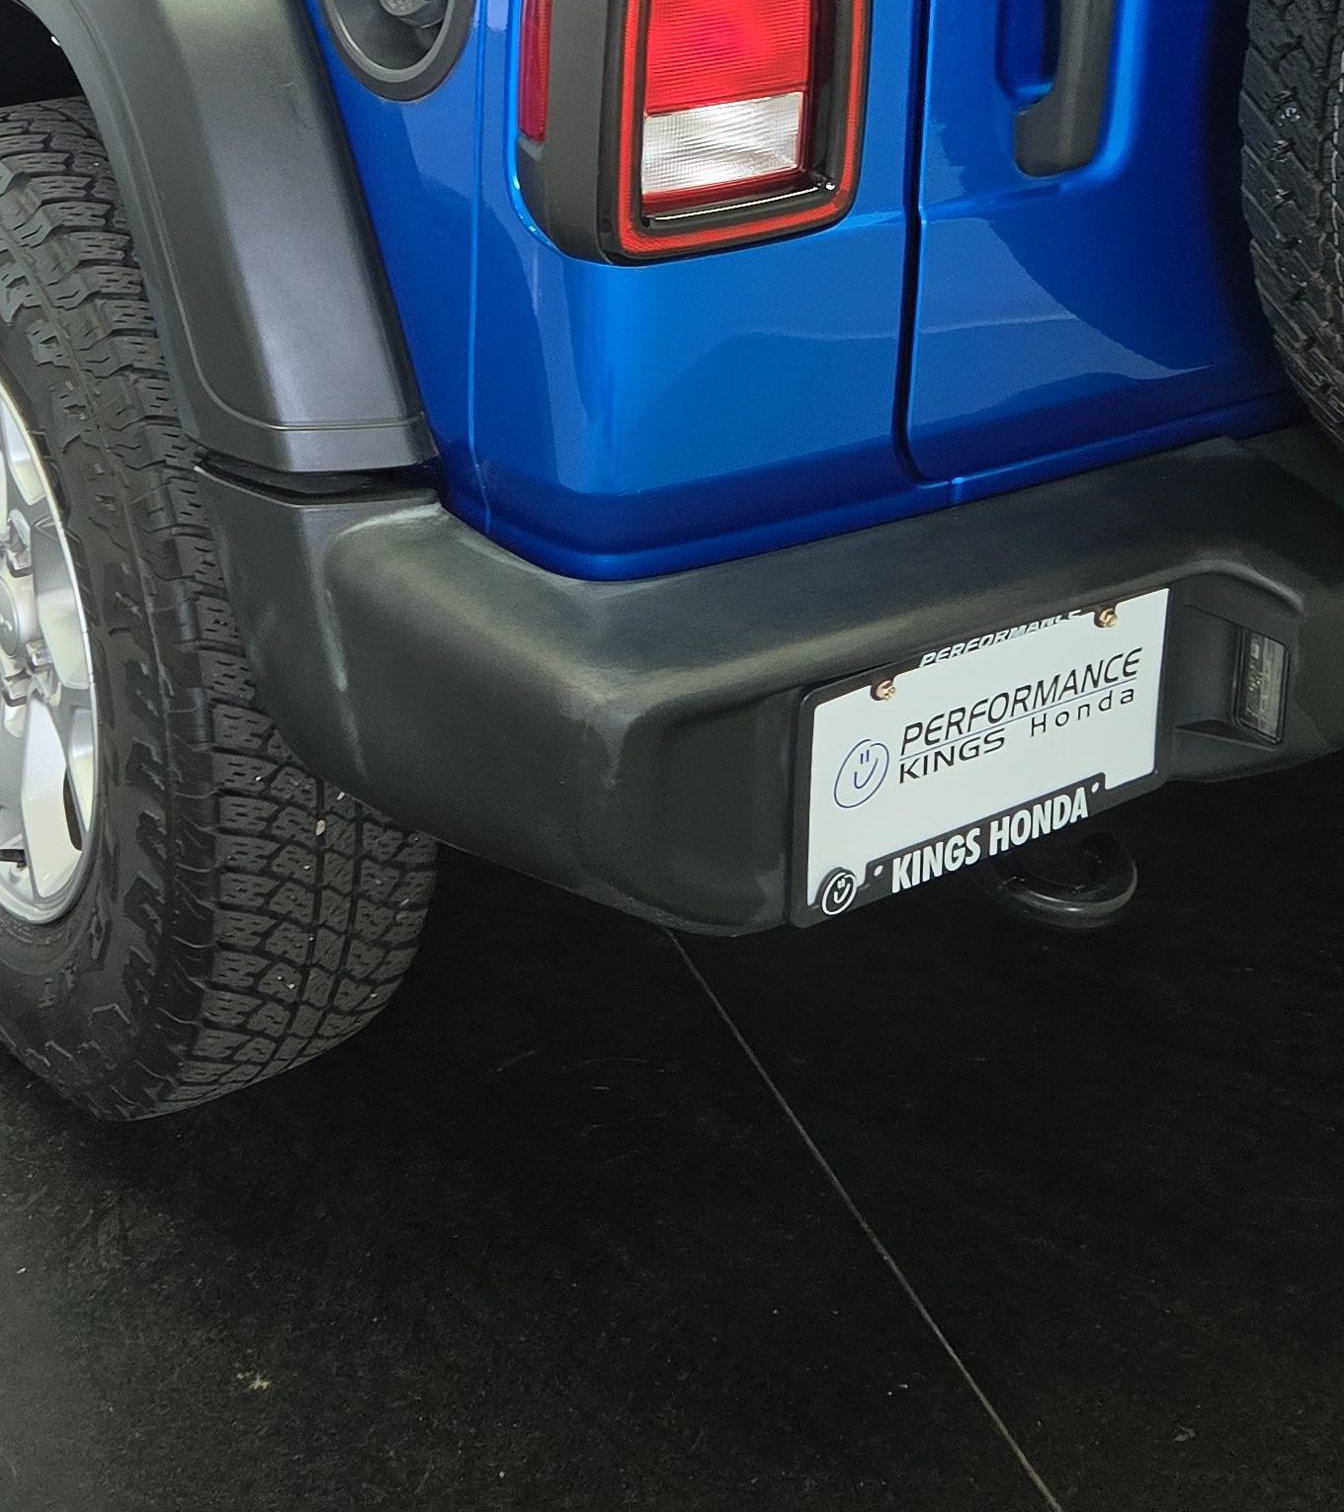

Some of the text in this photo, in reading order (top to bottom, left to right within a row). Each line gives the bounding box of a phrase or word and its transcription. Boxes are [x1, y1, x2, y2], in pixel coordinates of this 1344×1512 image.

[900, 687, 1134, 784] KINGS Honda
[901, 646, 1143, 756] PERFORMANCE
[891, 787, 1089, 894] KINGS HONDA
